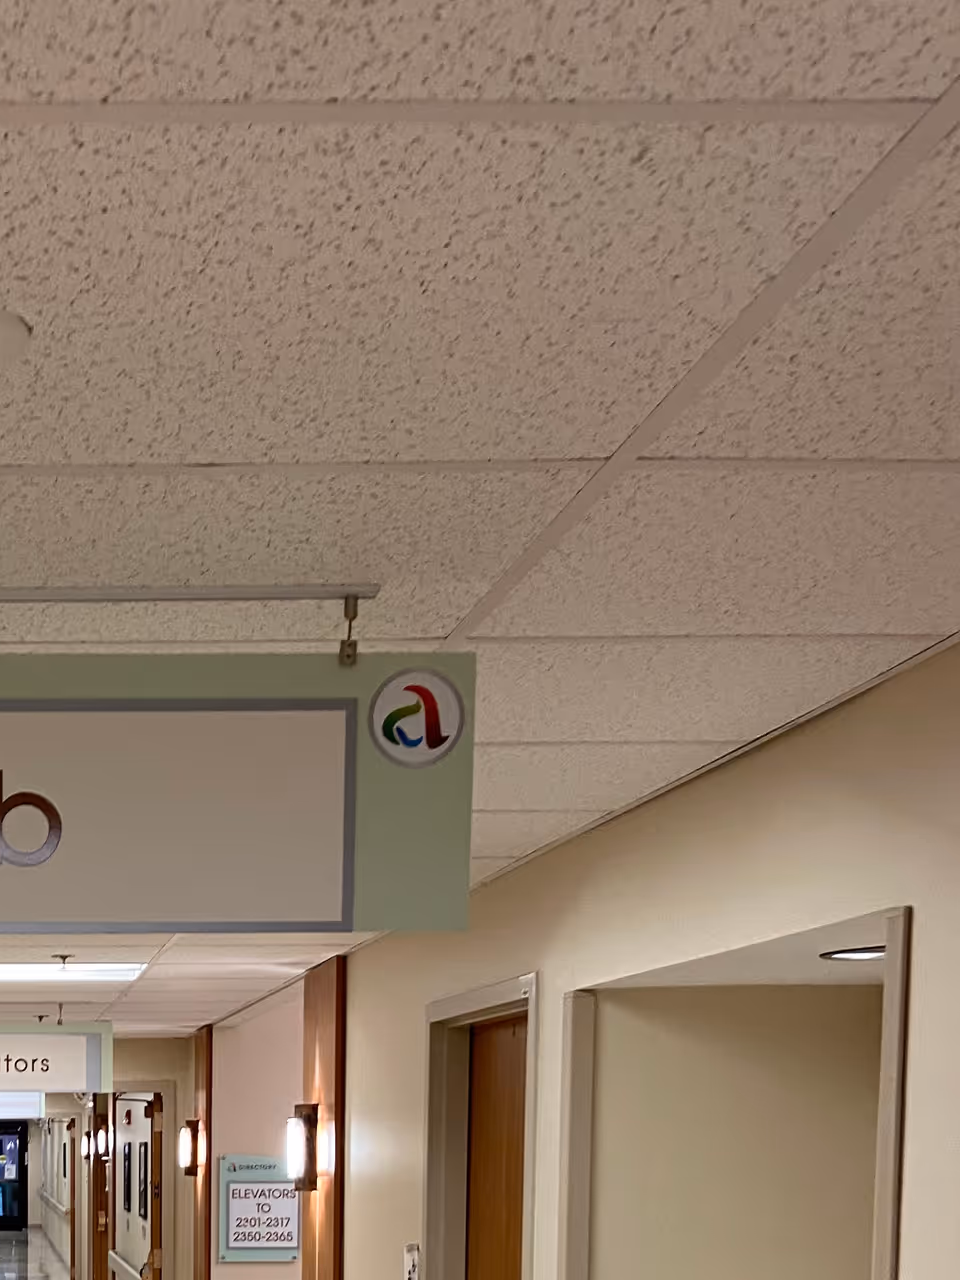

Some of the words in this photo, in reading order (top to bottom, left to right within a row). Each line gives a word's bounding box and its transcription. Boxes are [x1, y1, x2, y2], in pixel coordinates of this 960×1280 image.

[231, 1188, 297, 1200] ELEVATORS
[255, 1202, 272, 1213] TO
[235, 1217, 291, 1228] 2301-2317
[232, 1231, 294, 1242] 2350-2365
